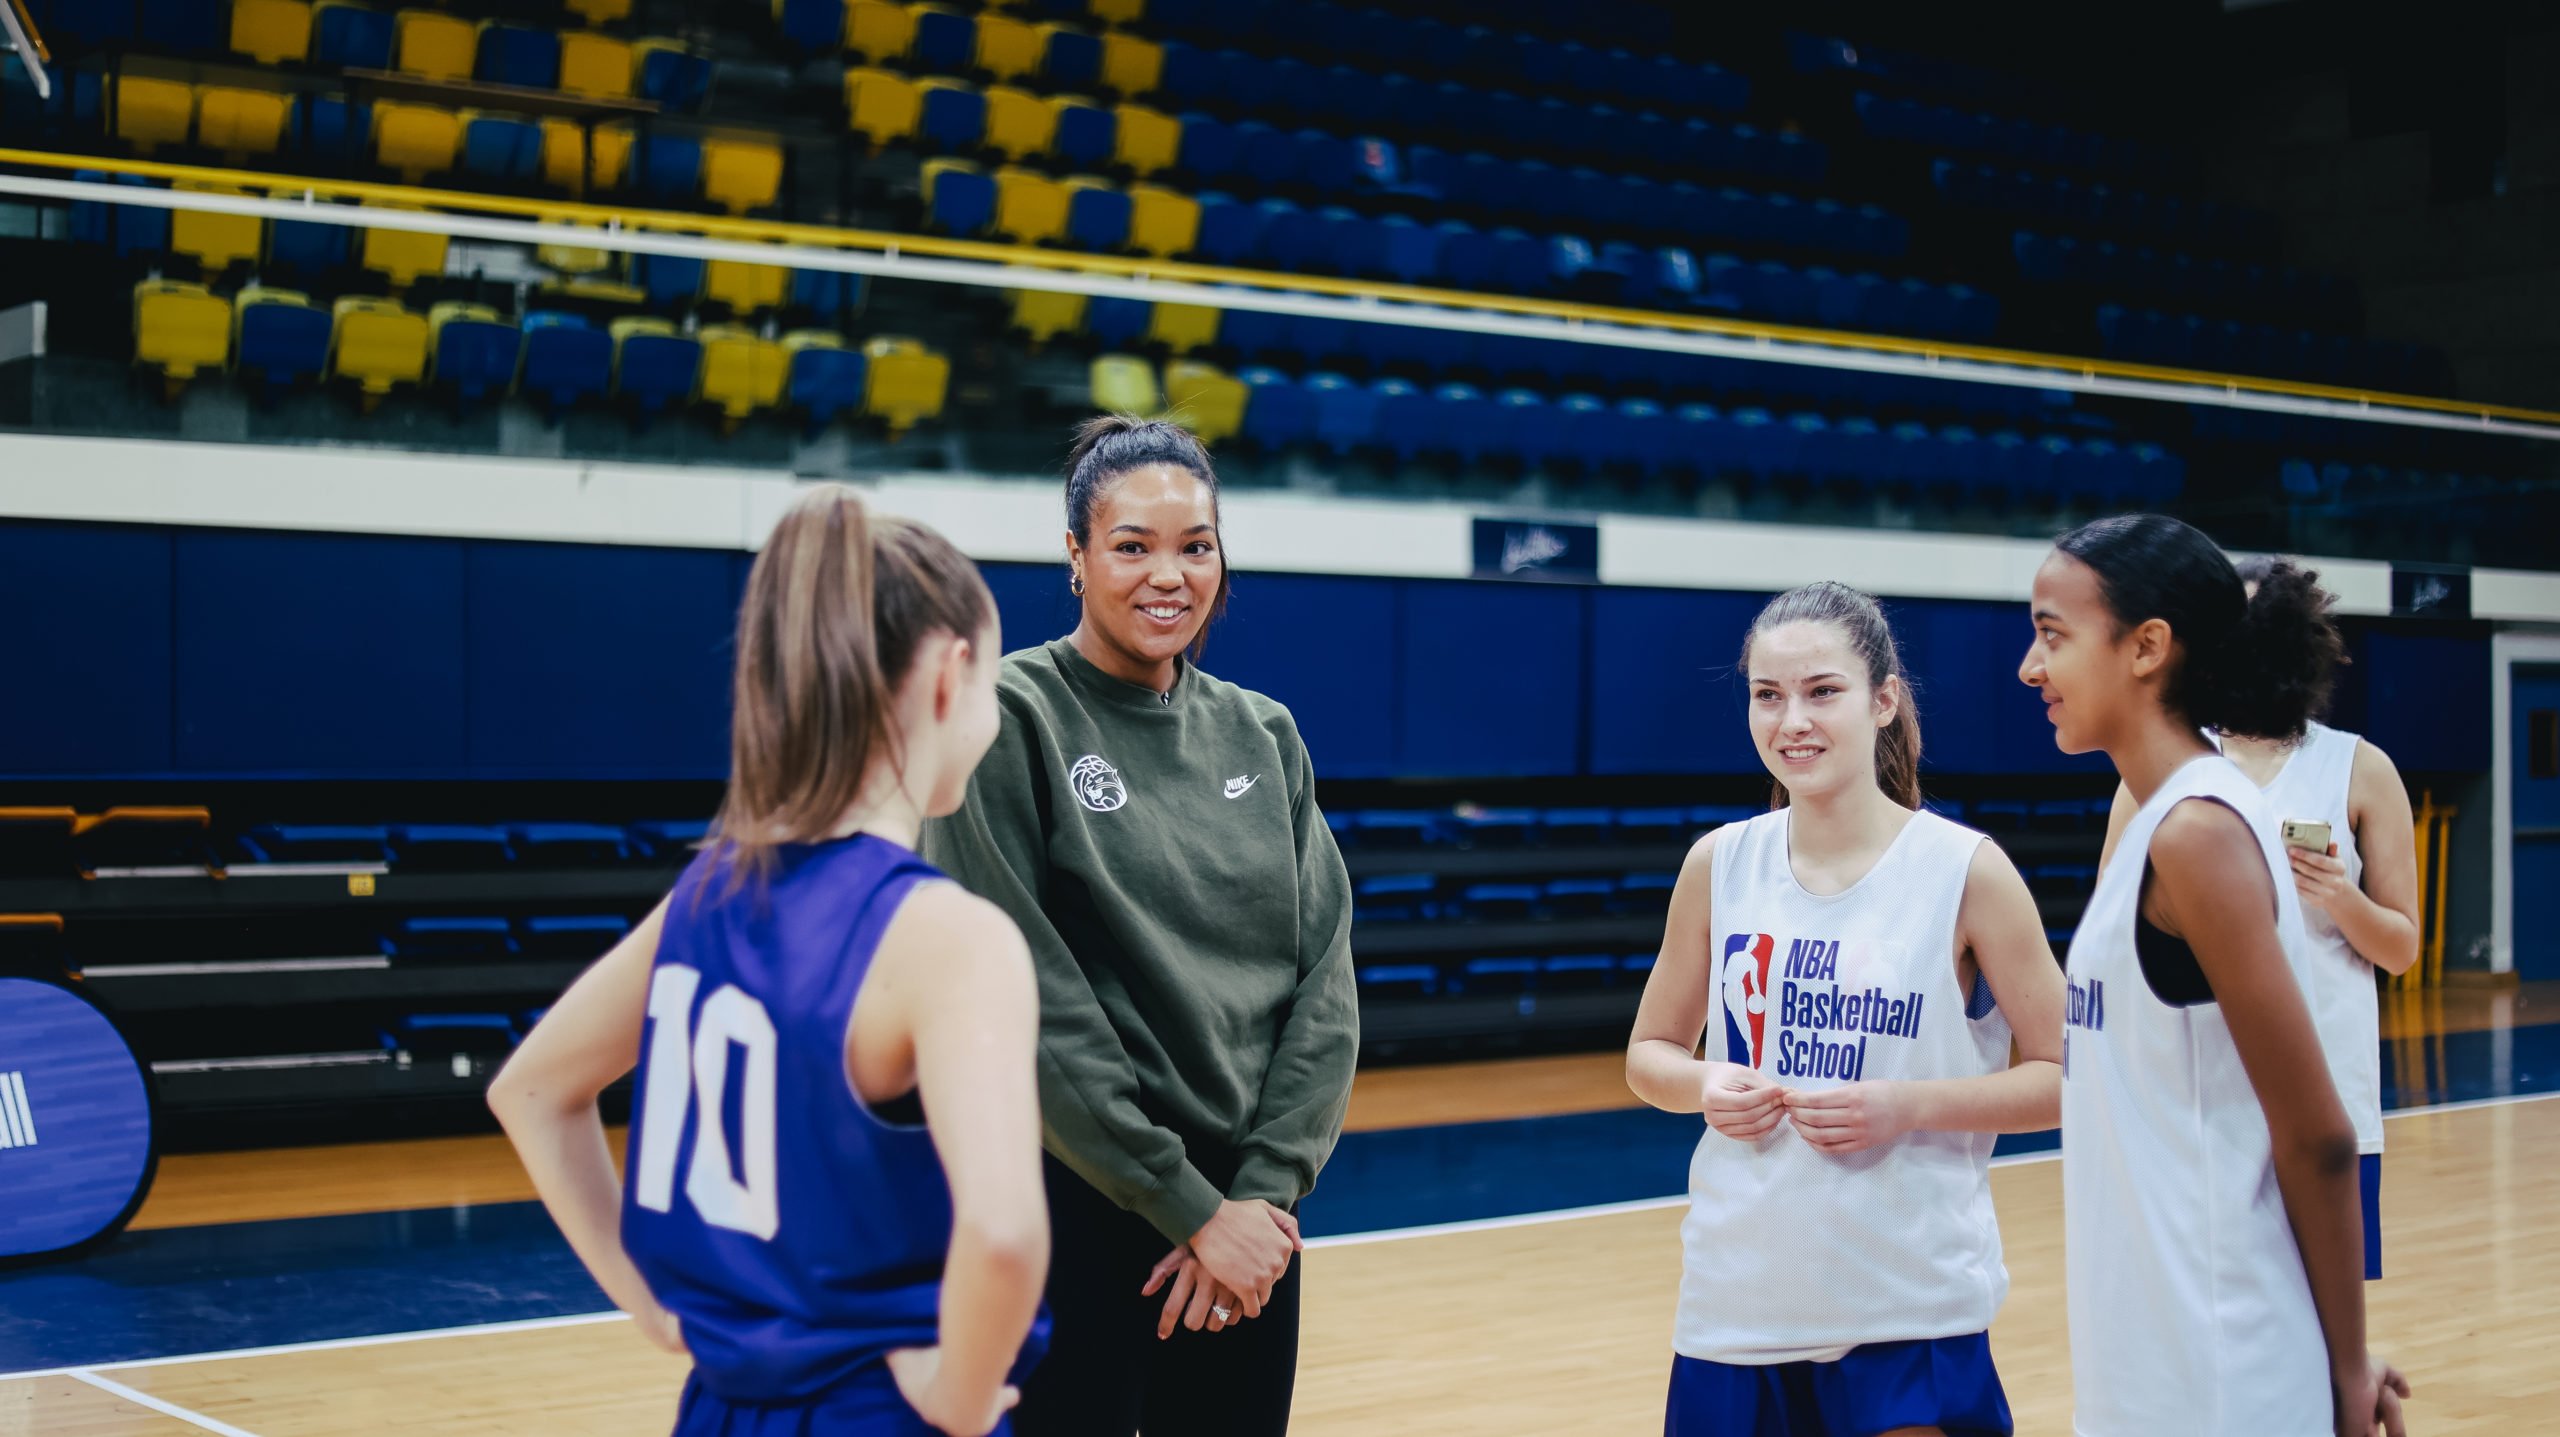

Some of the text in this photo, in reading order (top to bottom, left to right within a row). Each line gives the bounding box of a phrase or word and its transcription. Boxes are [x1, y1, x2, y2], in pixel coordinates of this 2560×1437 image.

[1225, 774, 1250, 791] NIKE
[1784, 938, 1840, 980] NBA
[1780, 981, 1924, 1039] Basketball
[1777, 1030, 1867, 1082] School
[636, 963, 780, 1242] 10
